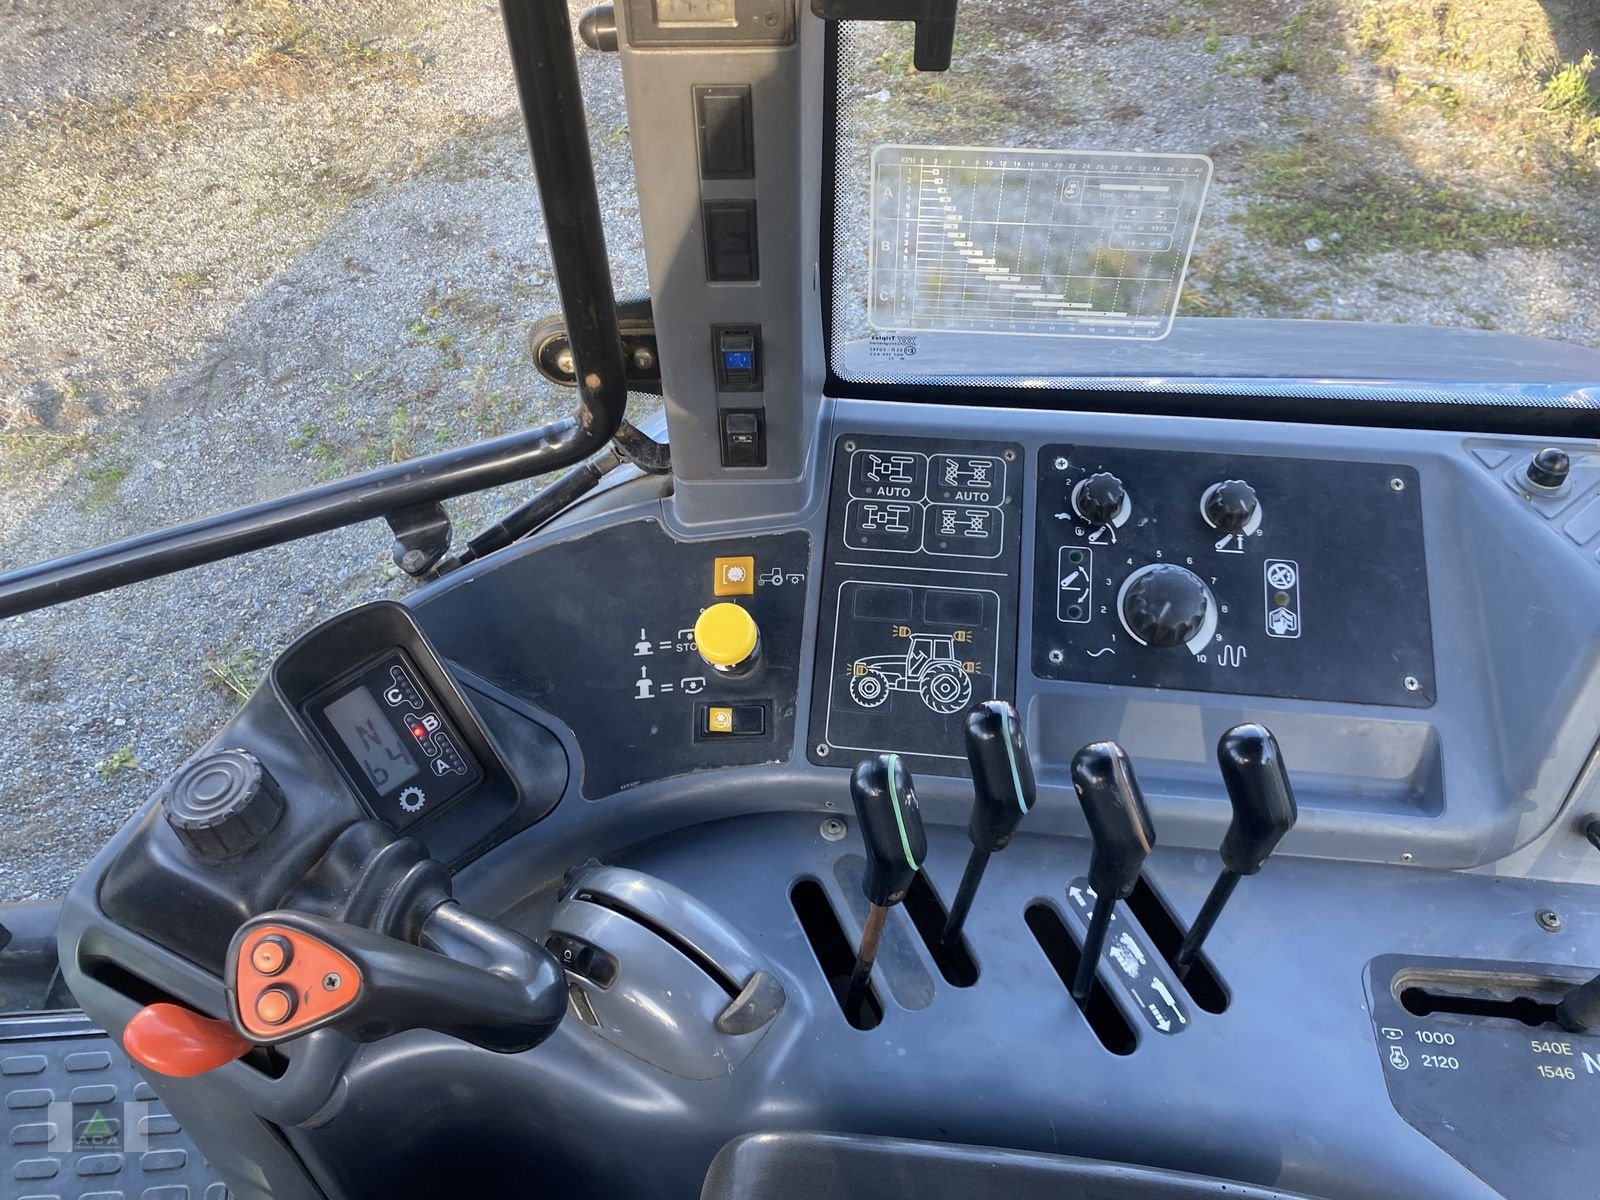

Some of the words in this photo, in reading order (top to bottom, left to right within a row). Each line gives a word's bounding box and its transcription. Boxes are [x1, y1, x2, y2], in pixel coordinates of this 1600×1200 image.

[884, 187, 893, 198] A
[881, 241, 890, 251] B
[880, 291, 888, 301] C
[1065, 478, 1072, 486] 2
[876, 486, 911, 498] AUTO
[954, 491, 990, 502] AUTO
[1156, 550, 1162, 558] 5
[1211, 577, 1217, 585] 7
[1221, 605, 1228, 613] 8
[676, 642, 698, 652] STO
[1196, 655, 1207, 663] 10
[387, 688, 403, 703] C
[421, 715, 439, 731] B
[436, 759, 450, 774] A
[1415, 1030, 1455, 1045] 1000
[1531, 1040, 1573, 1056] 540E
[1421, 1054, 1459, 1070] 2120
[1537, 1065, 1576, 1080] 1546
